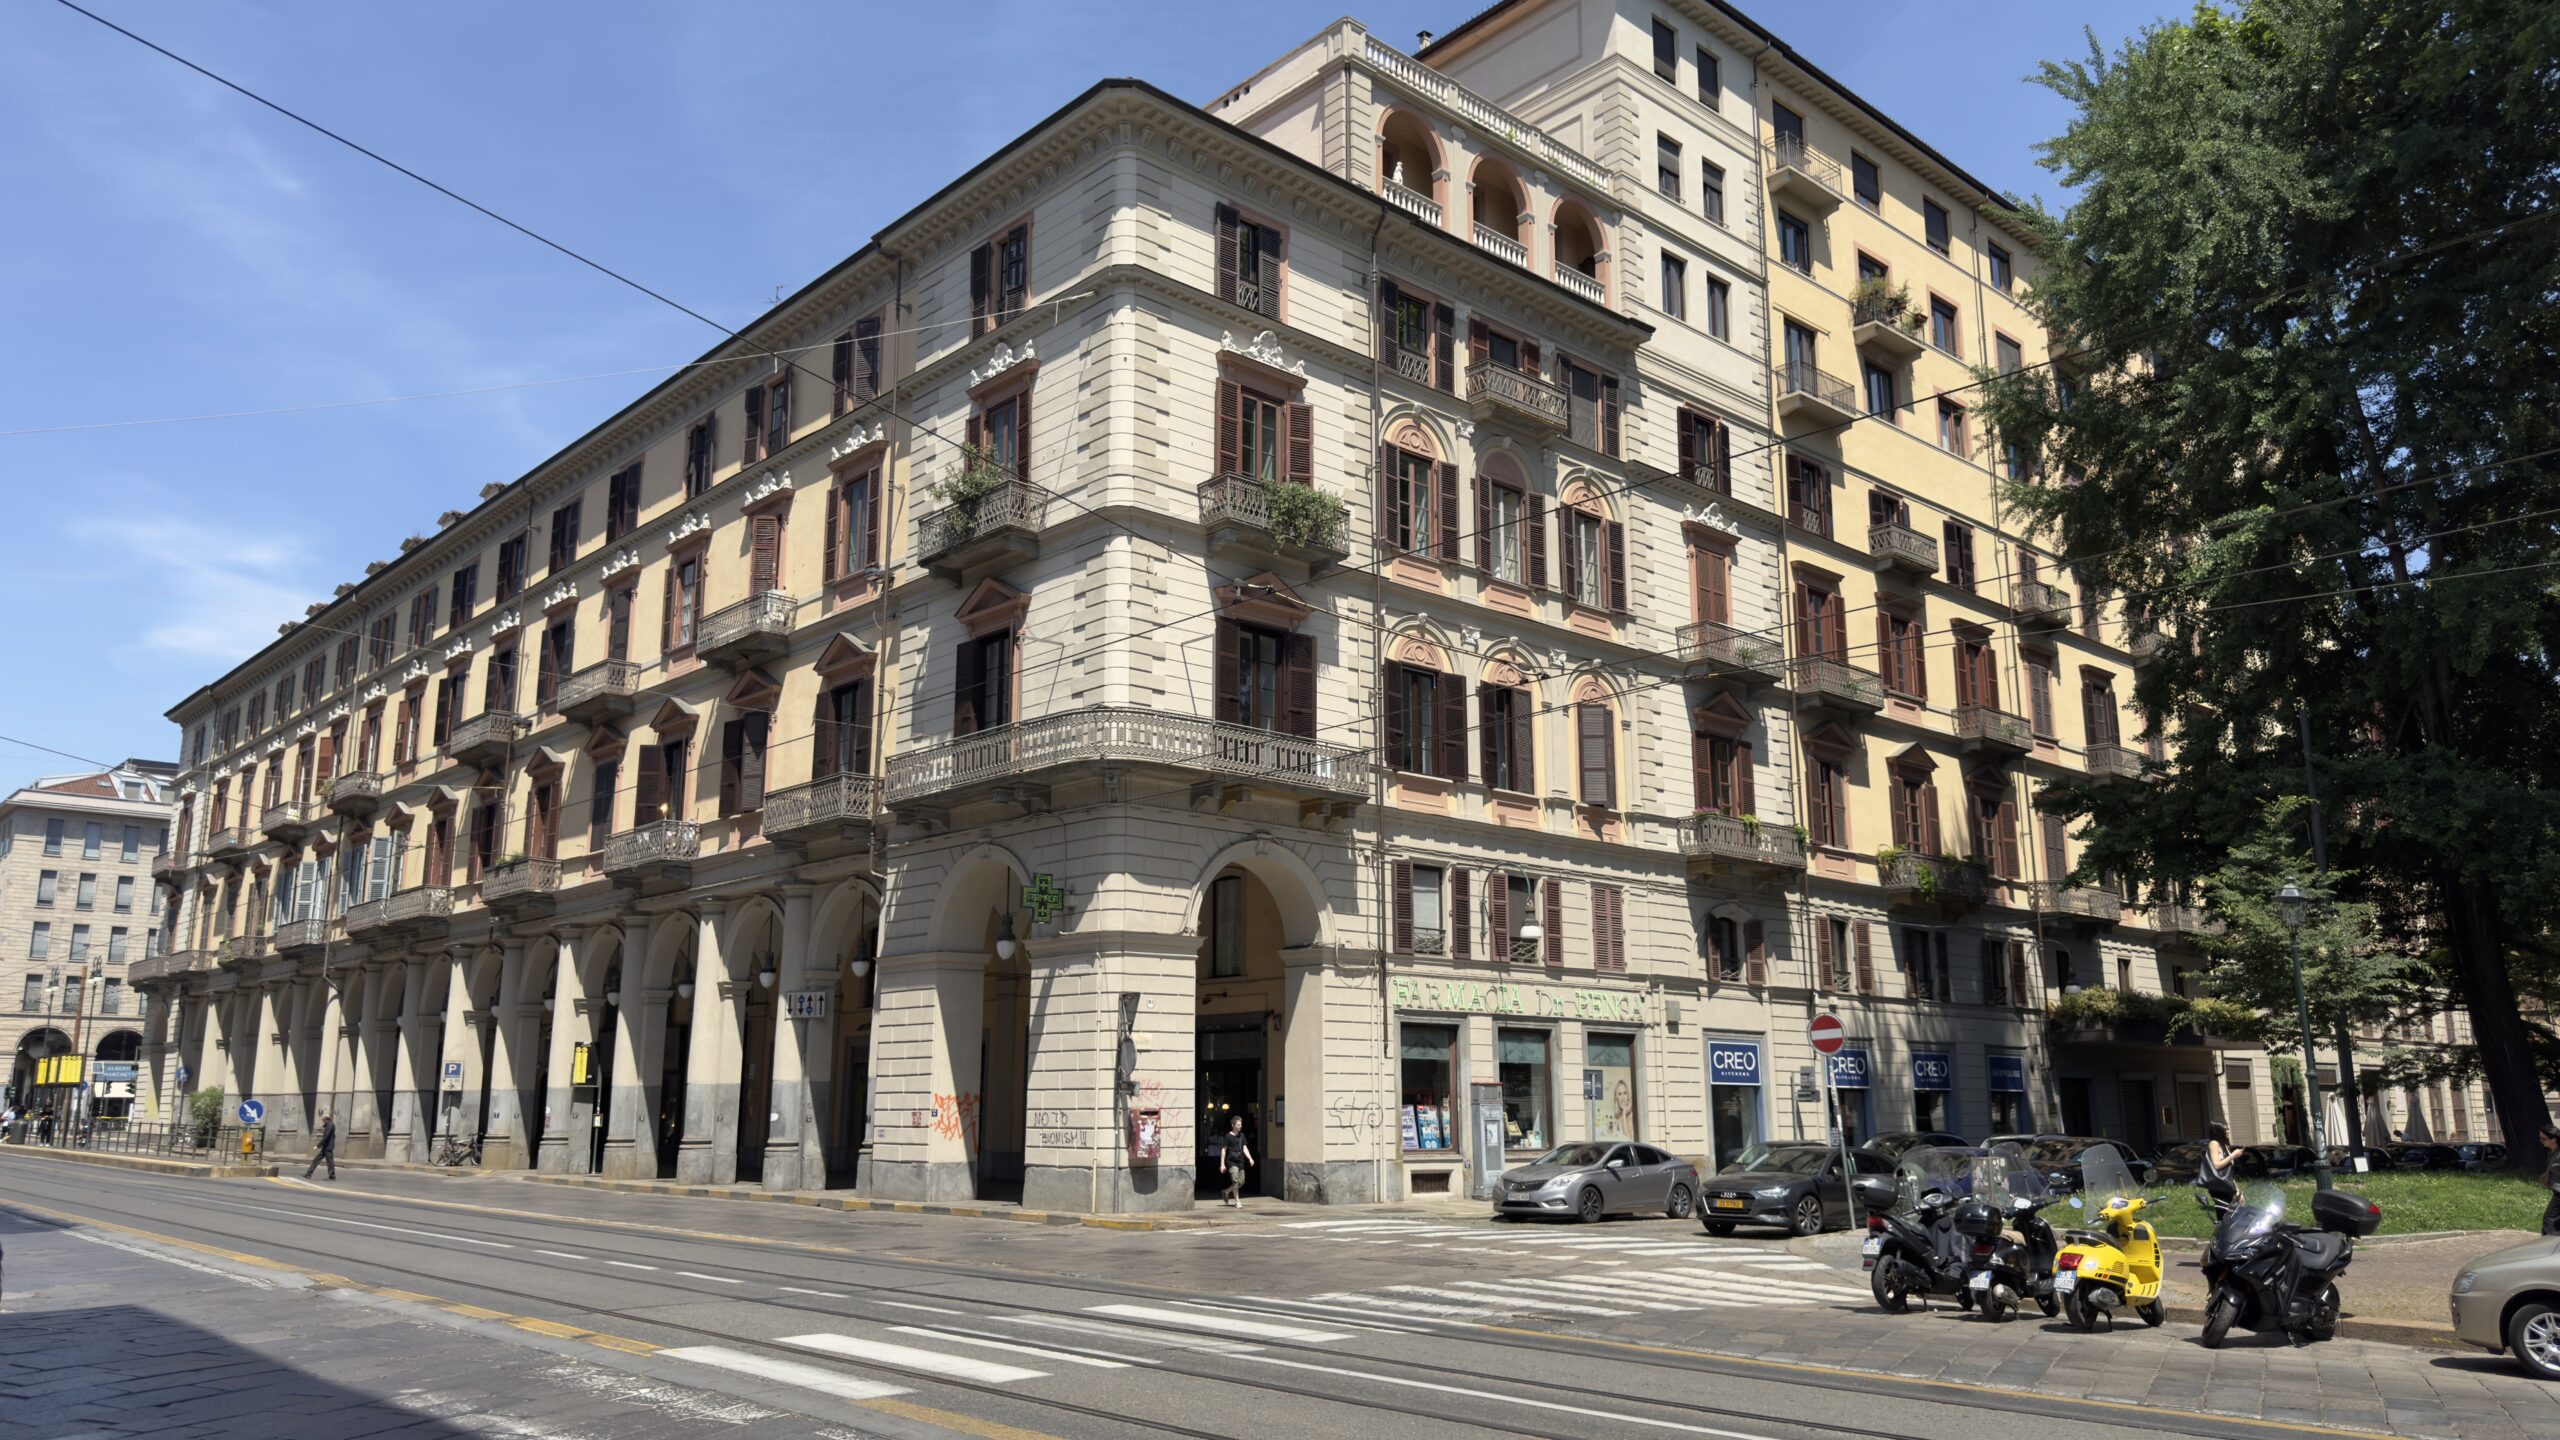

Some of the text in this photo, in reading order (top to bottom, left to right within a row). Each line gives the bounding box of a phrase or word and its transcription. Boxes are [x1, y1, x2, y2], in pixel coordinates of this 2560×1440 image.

[1392, 976, 1526, 1014] FARMACIA
[1574, 991, 1645, 1022] PENSA
[448, 1064, 457, 1074] P
[1713, 1050, 1756, 1071] CREO
[1831, 1056, 1866, 1075] CREO
[1914, 1060, 1948, 1078] CREO
[1034, 1112, 1049, 1126] NO
